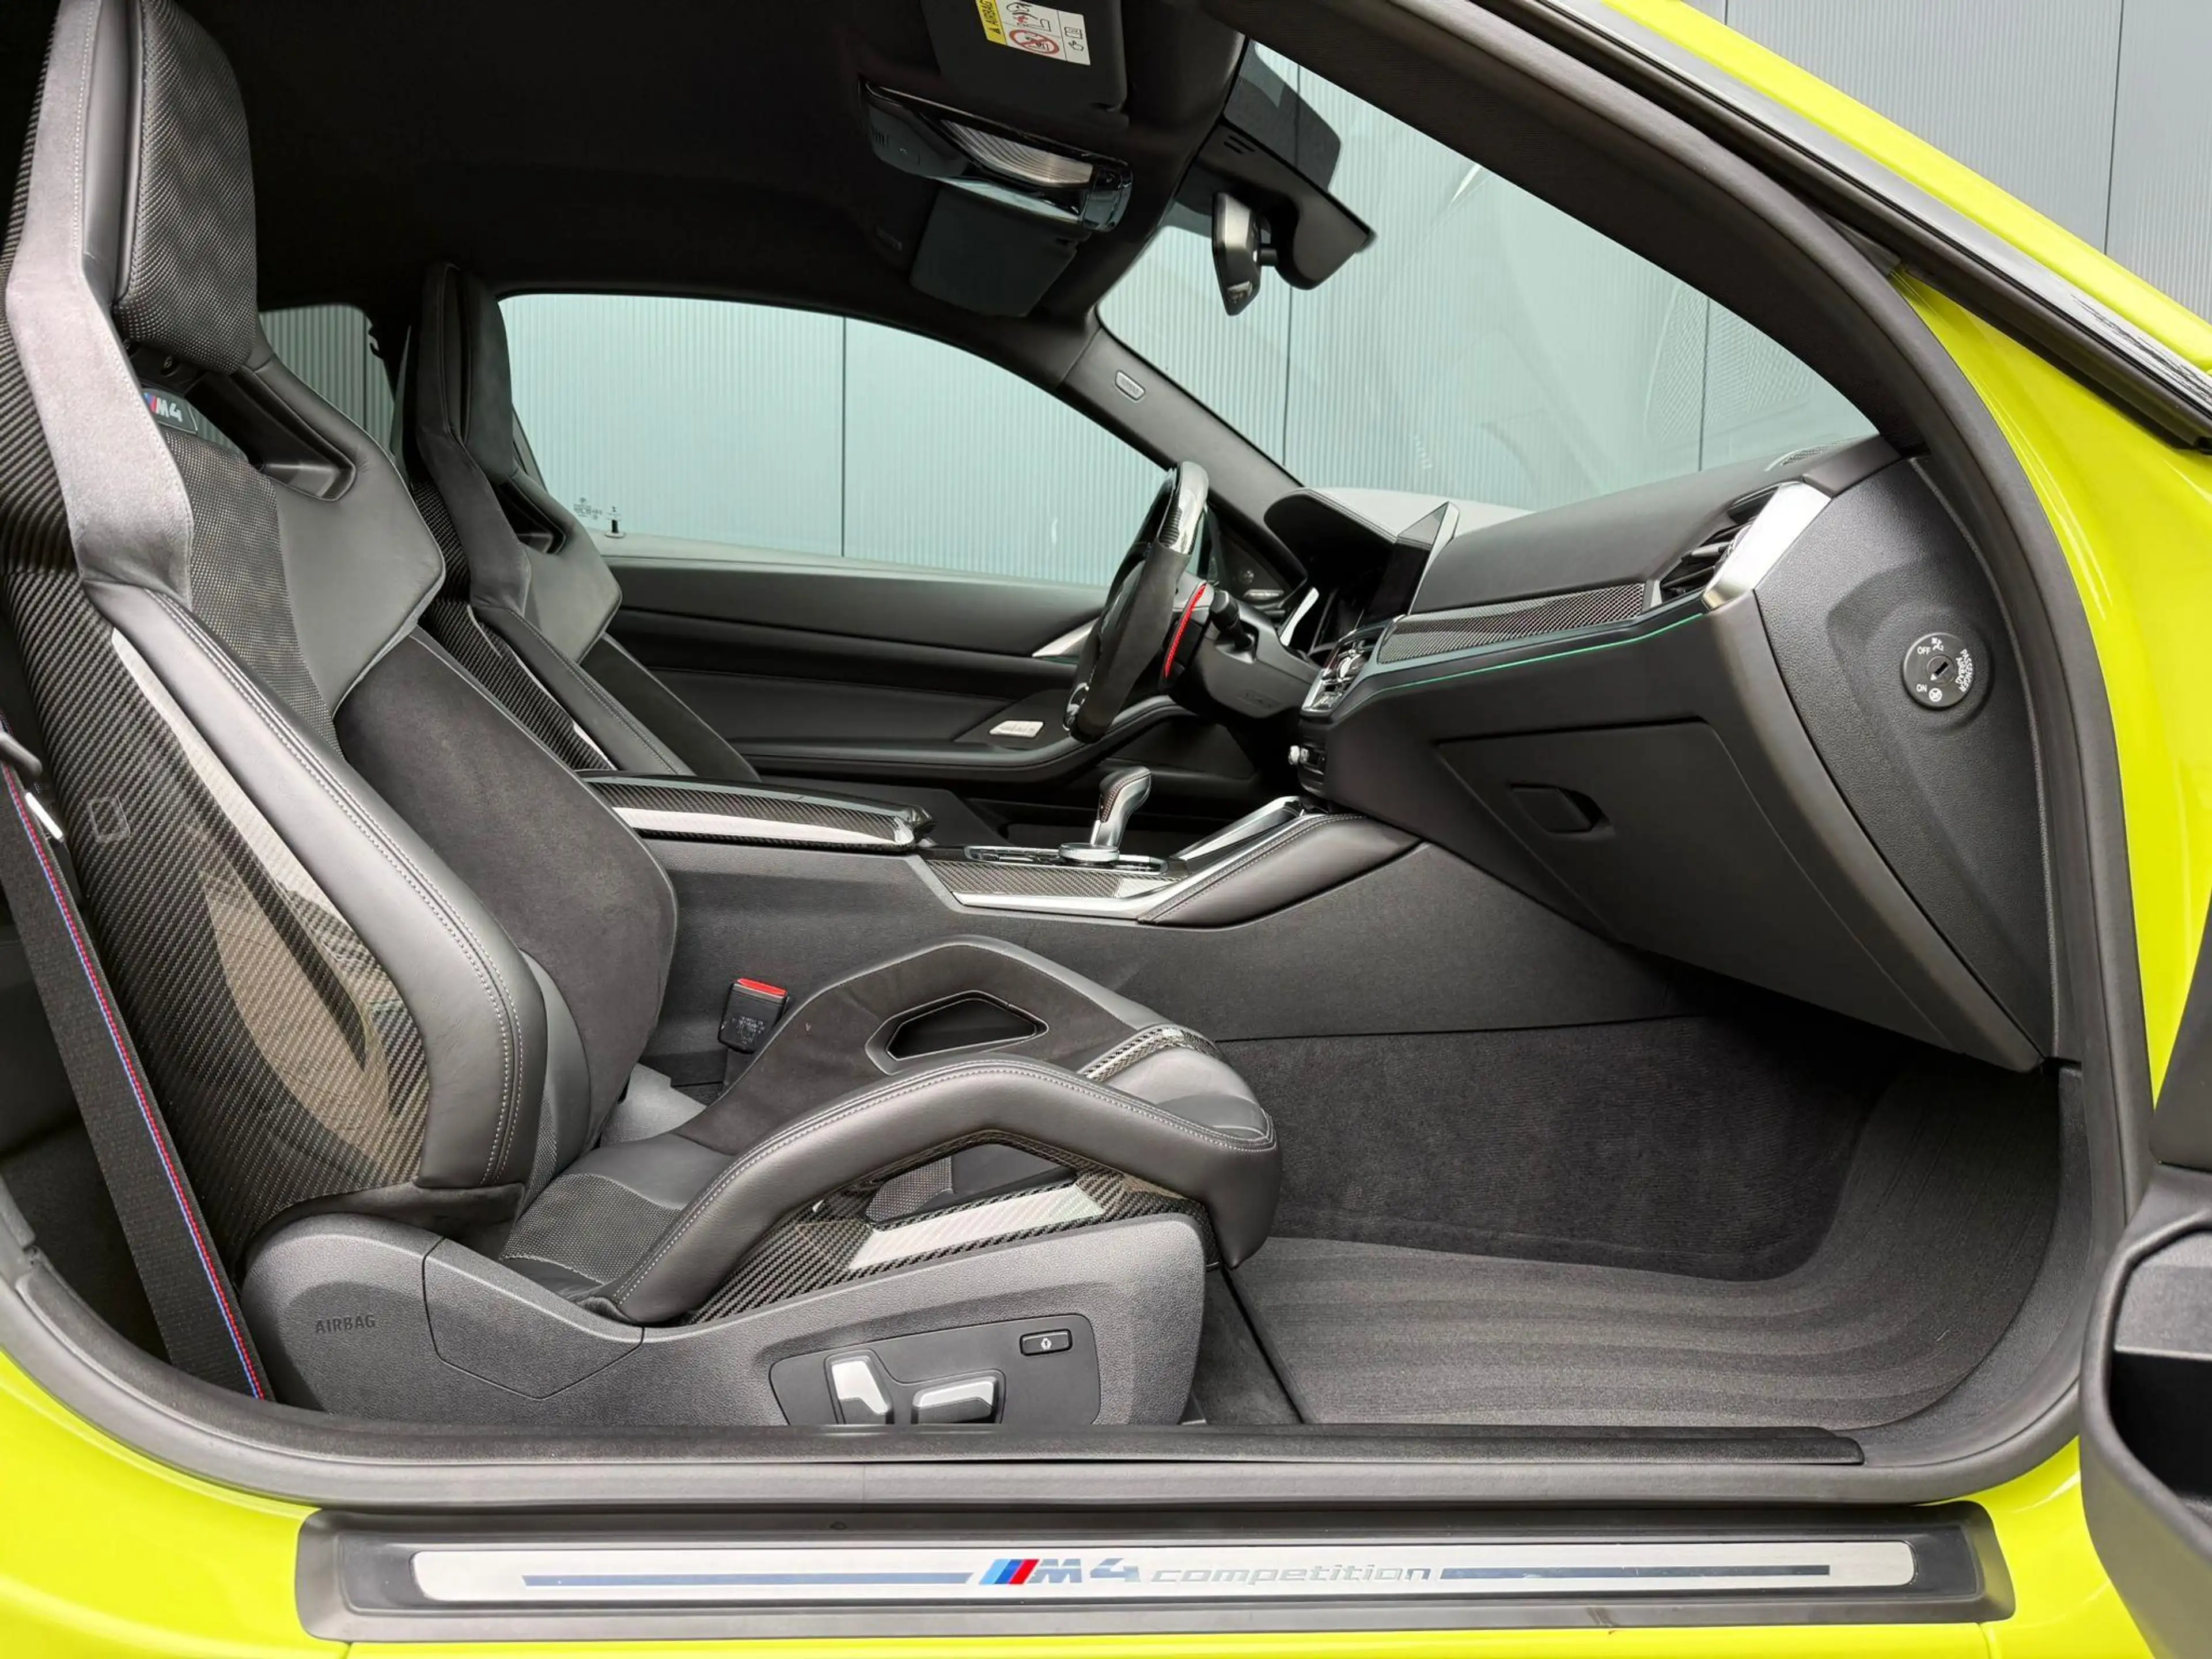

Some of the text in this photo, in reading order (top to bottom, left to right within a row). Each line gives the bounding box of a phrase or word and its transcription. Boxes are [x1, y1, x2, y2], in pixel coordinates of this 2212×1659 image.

[155, 397, 183, 422] M4
[1917, 646, 1930, 655] OFF
[1955, 657, 1964, 684] AIRBAG
[1959, 649, 1972, 692] PASSENGER
[1916, 684, 1927, 692] ON
[316, 1315, 374, 1332] AIRBAG
[1151, 1564, 1431, 1585] competition
